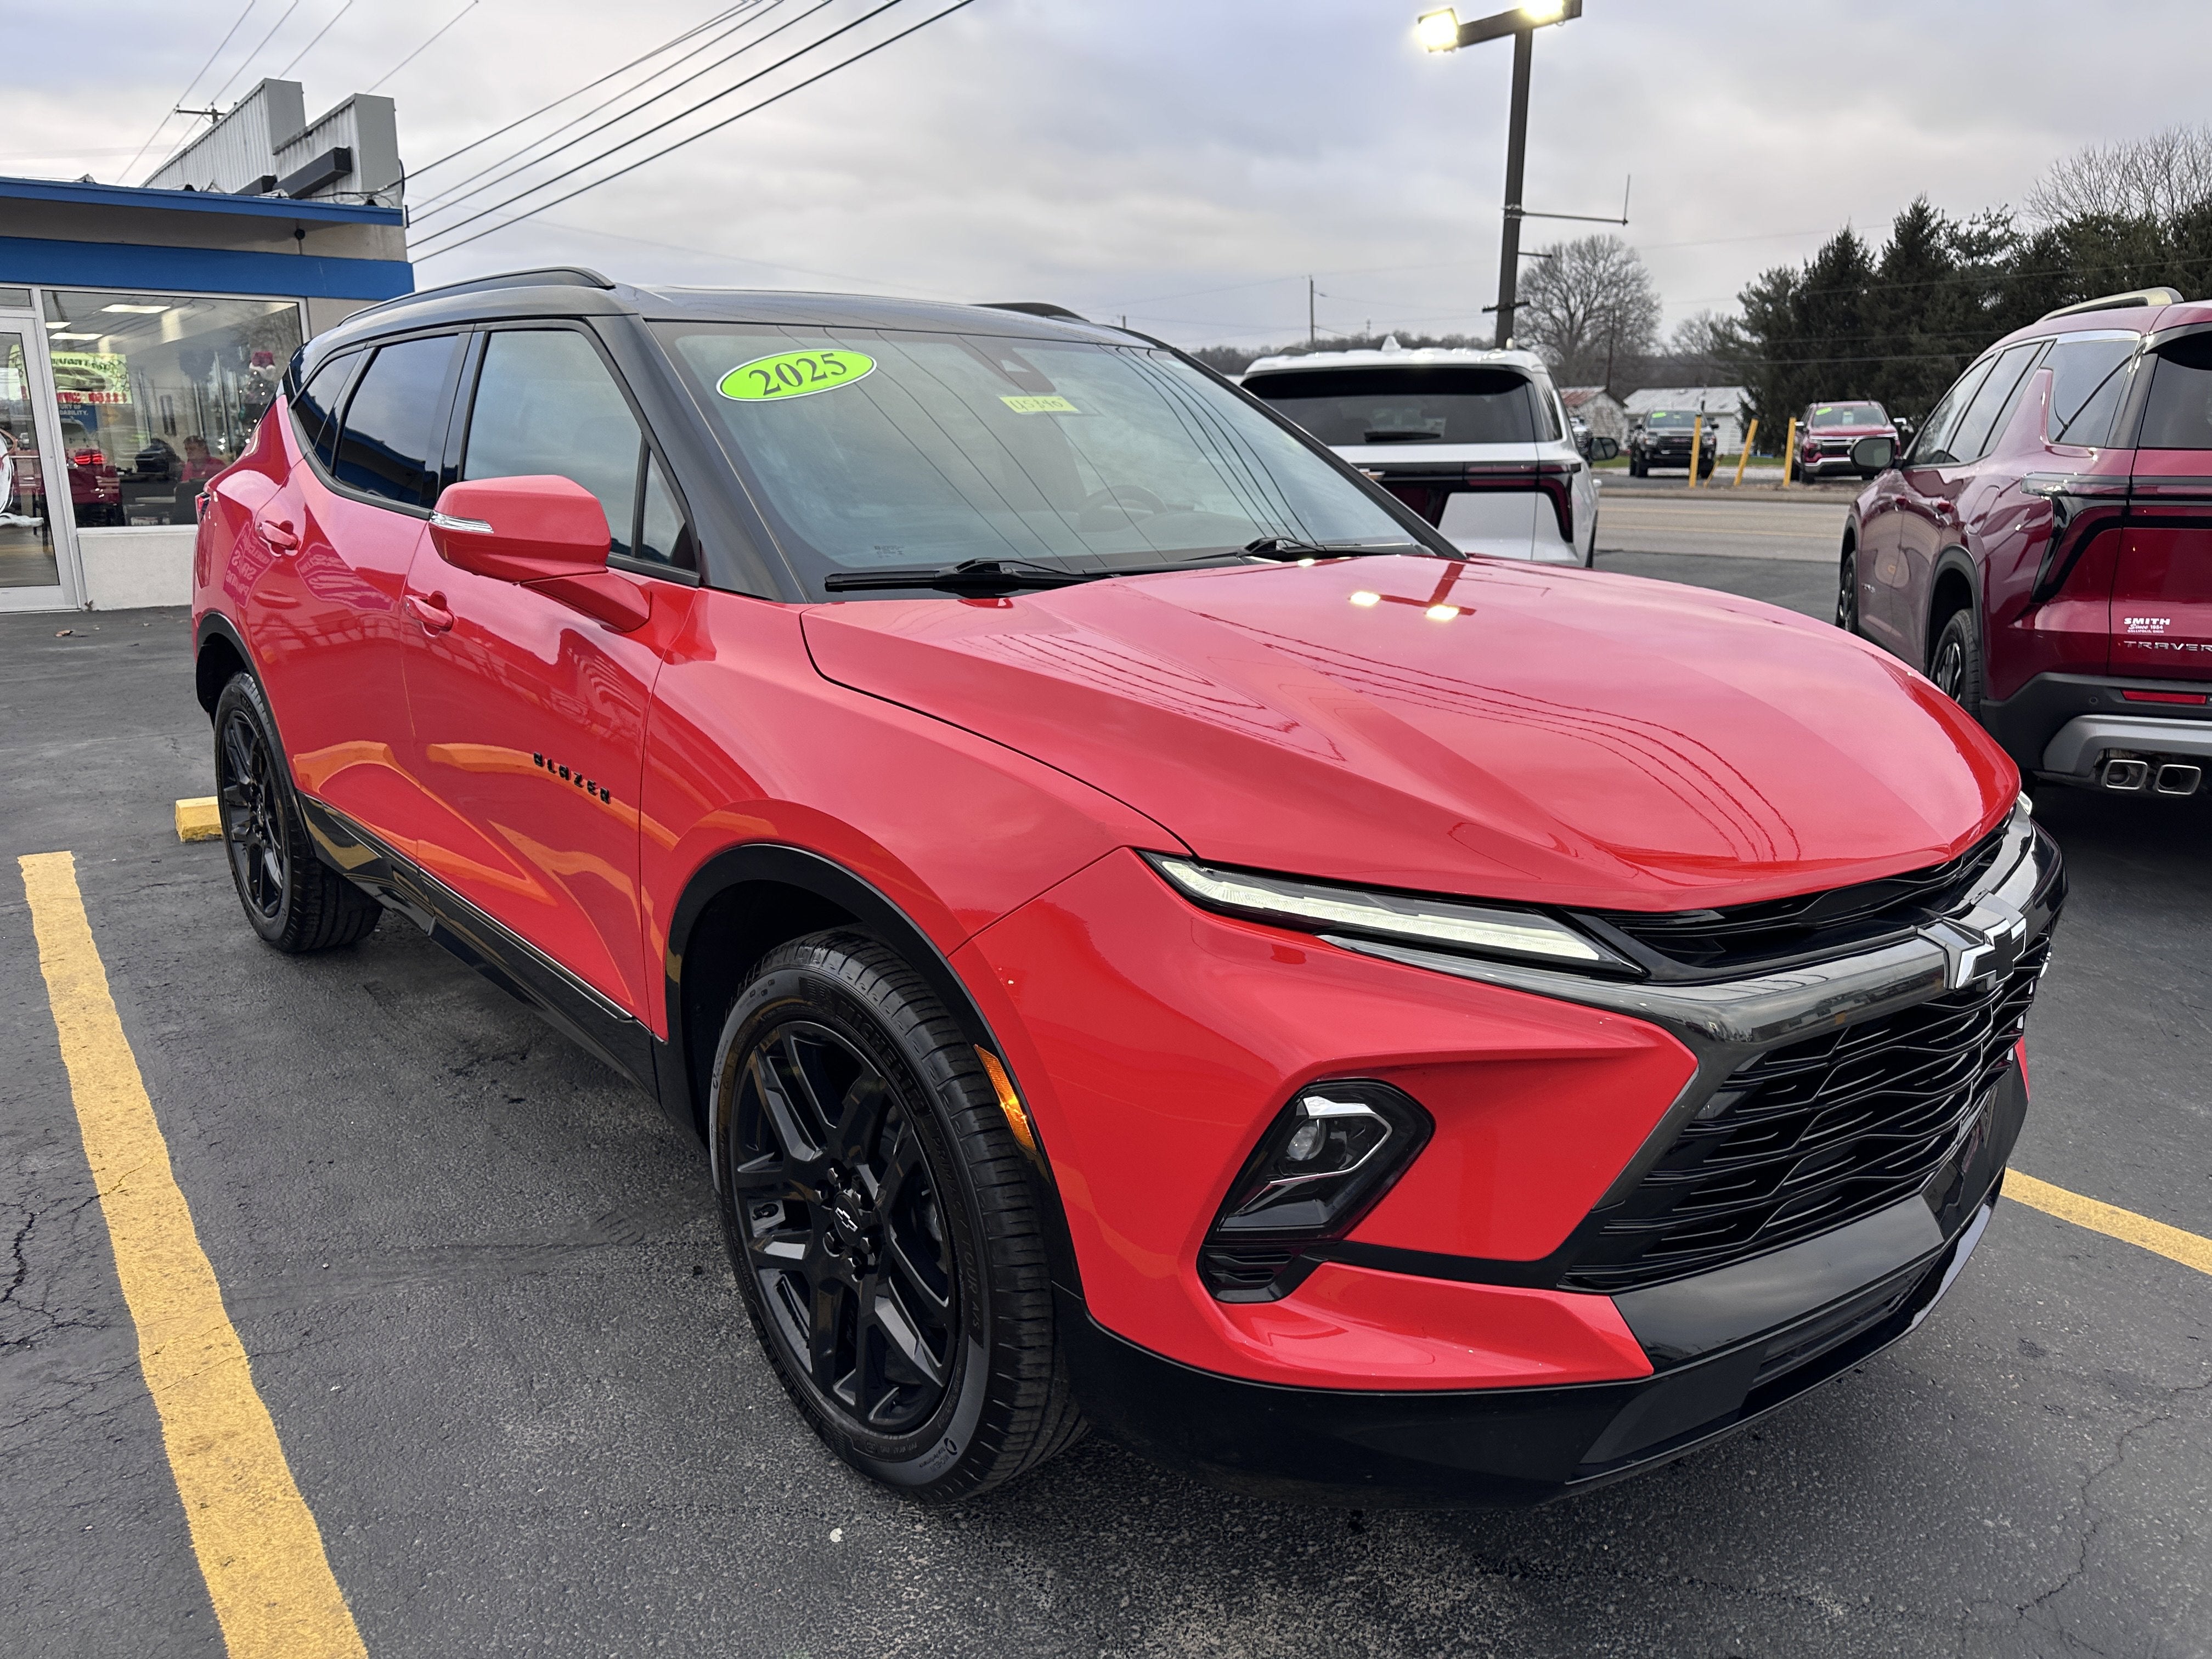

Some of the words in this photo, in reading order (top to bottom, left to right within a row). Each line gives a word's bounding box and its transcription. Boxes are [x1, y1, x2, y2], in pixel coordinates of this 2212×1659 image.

[748, 352, 847, 396] 2025
[2123, 617, 2171, 625] SMITH
[533, 752, 611, 805] BLAZER
[834, 998, 926, 1113] MICHELIN
[962, 1240, 978, 1295] TOUR
[972, 1300, 980, 1329] A/S
